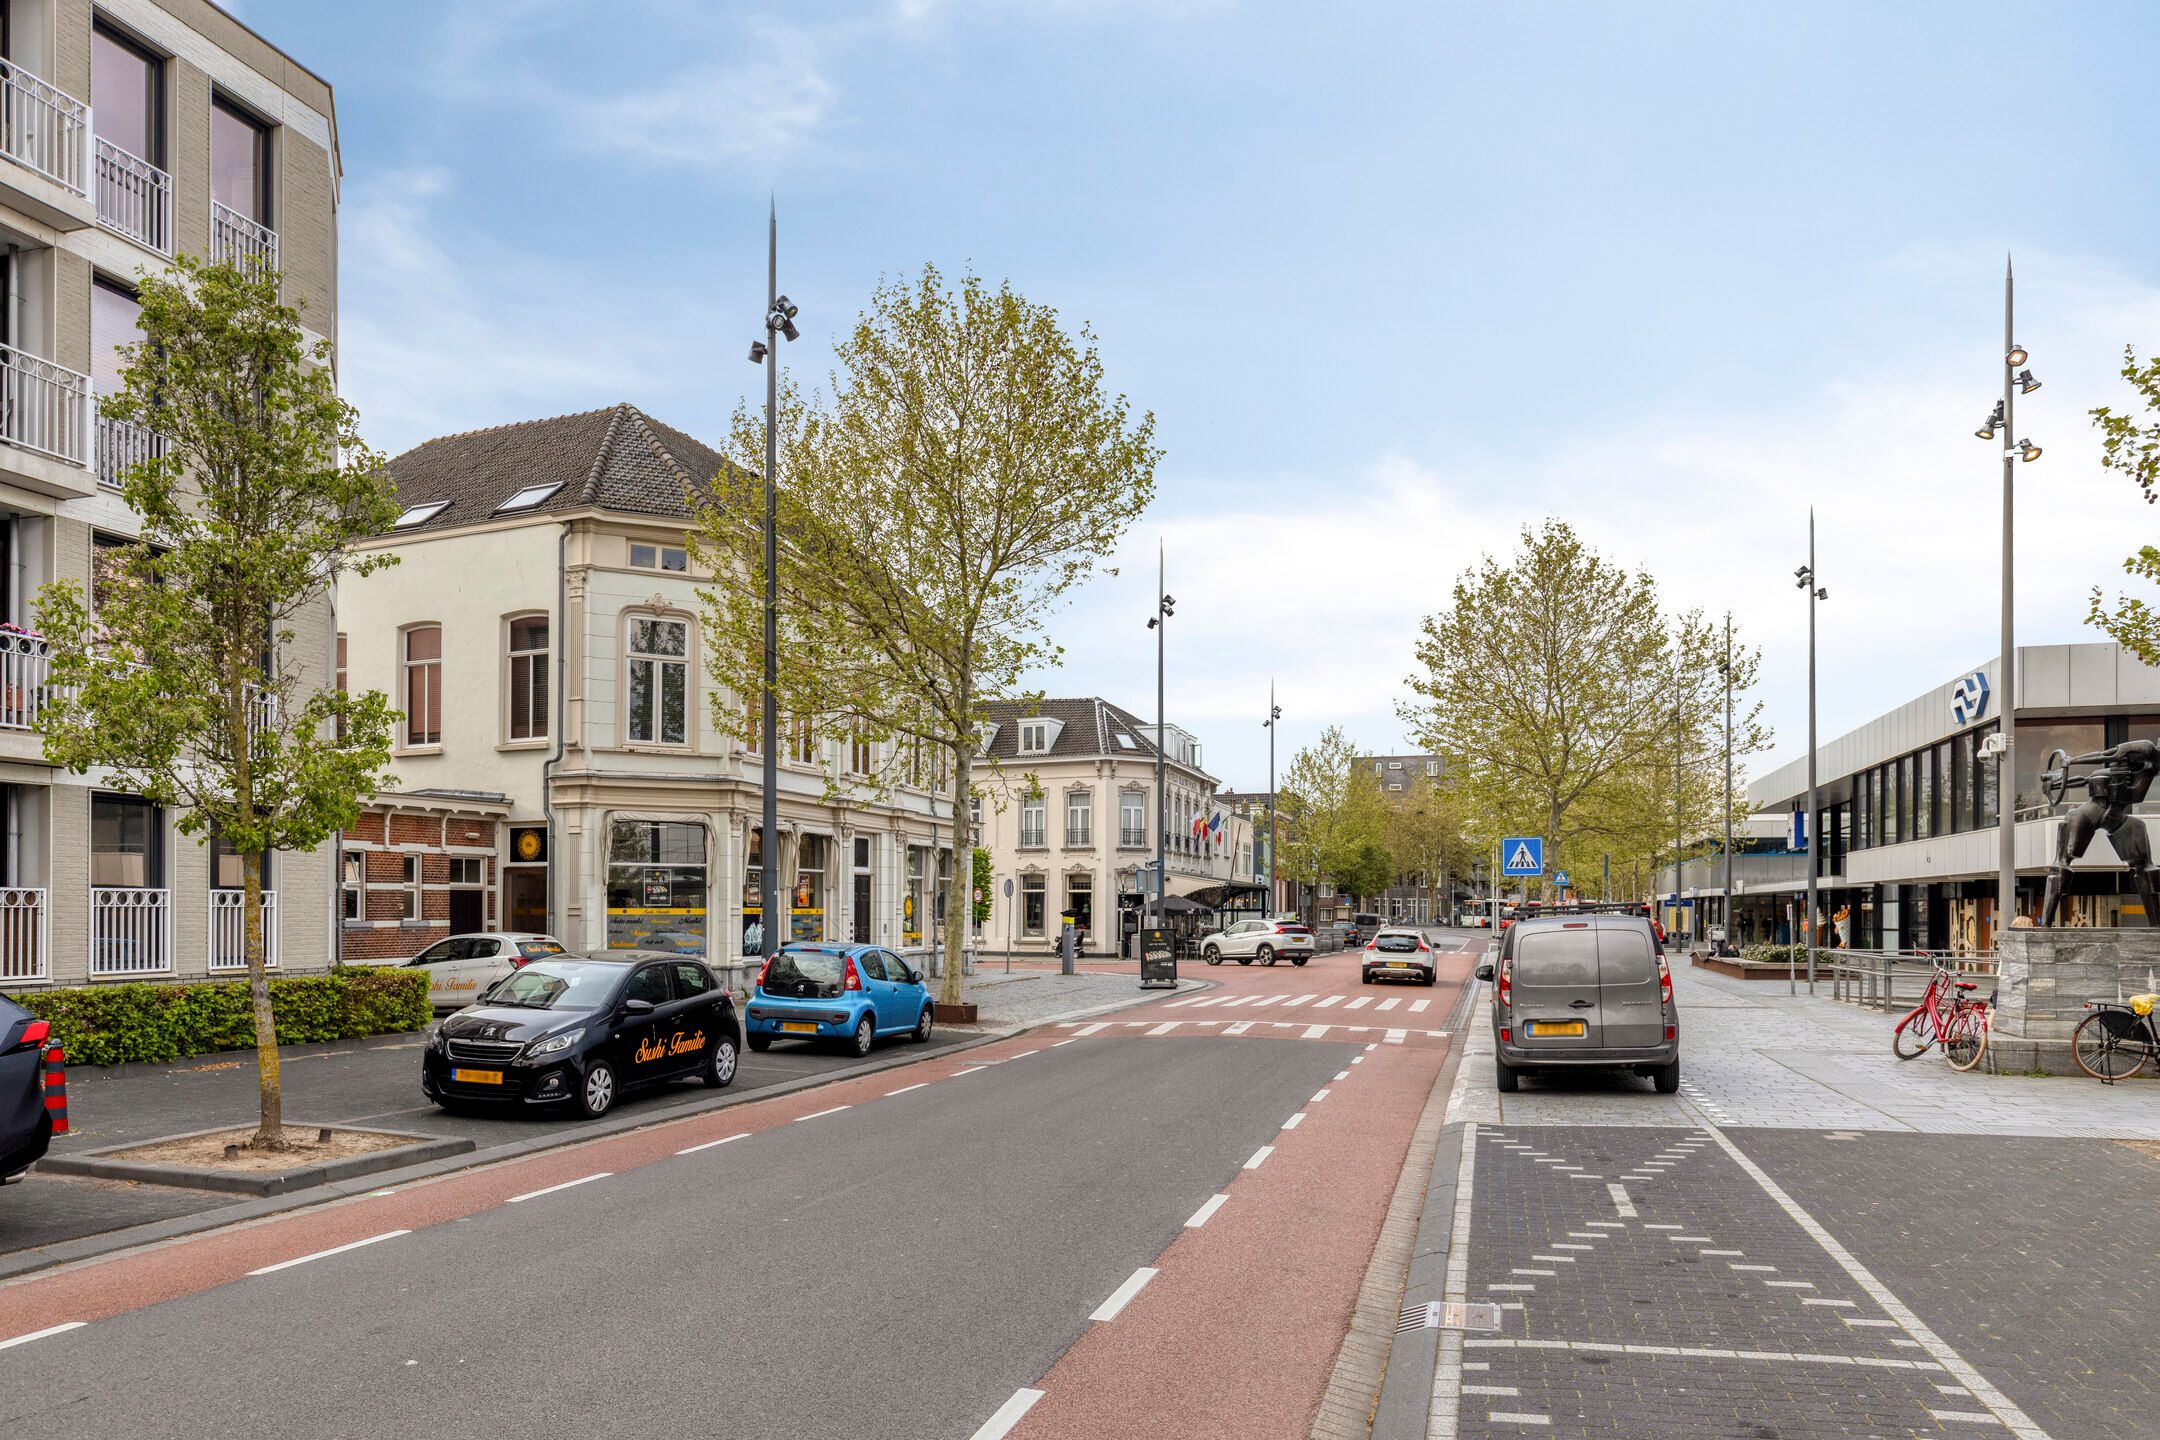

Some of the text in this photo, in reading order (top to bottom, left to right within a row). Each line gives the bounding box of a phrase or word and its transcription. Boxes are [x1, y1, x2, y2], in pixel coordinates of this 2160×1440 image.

[445, 976, 478, 991] Familie
[635, 1030, 706, 1064] Sushi Familie
